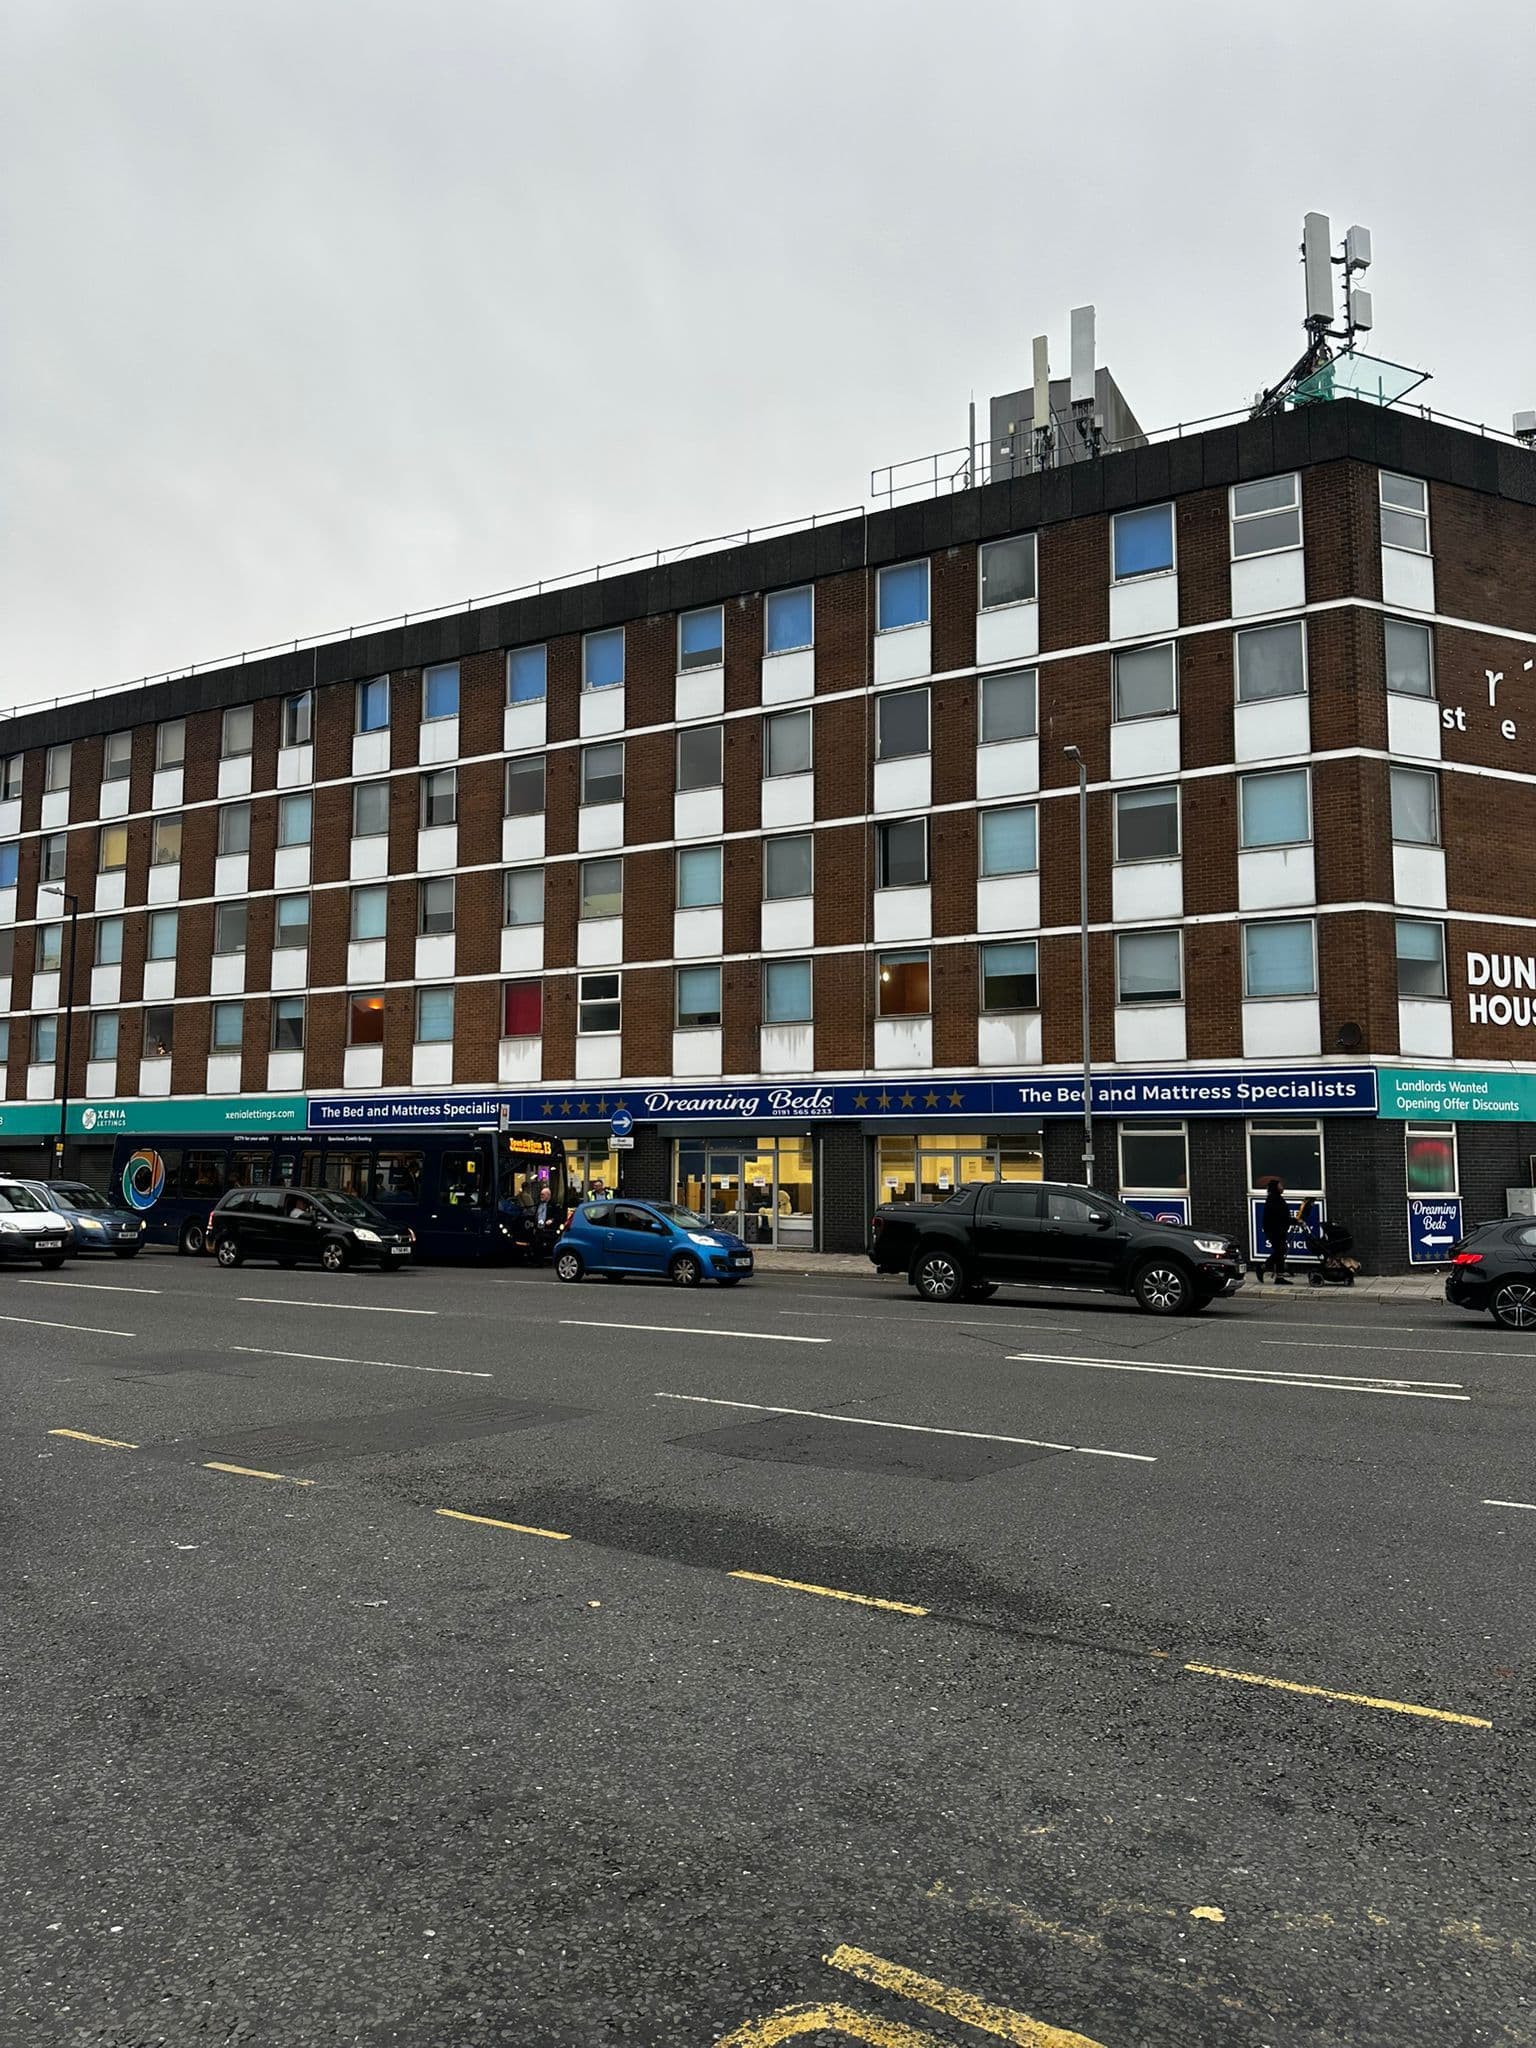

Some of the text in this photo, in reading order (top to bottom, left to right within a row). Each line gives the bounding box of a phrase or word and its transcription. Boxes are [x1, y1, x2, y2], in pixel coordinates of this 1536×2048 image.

[1442, 707, 1467, 731] st
[1469, 993, 1536, 1027] HOU
[1019, 1081, 1357, 1102] The Bed and Mattress Specialists
[1396, 1080, 1488, 1094] Landlords Wanted
[320, 1106, 341, 1118] The
[343, 1105, 364, 1118] Bed
[367, 1104, 389, 1117] and
[392, 1103, 441, 1117] Mattress
[443, 1102, 499, 1118] Specialist
[644, 1088, 833, 1117] Dreaming Beds
[1396, 1097, 1520, 1112] Opening Offer Discounts
[97, 1109, 126, 1119] XENIA
[225, 1109, 295, 1121] xenialettings.com
[96, 1119, 126, 1127] LETTINGS
[1412, 1200, 1457, 1220] Dreaming
[1423, 1215, 1447, 1231] Beds
